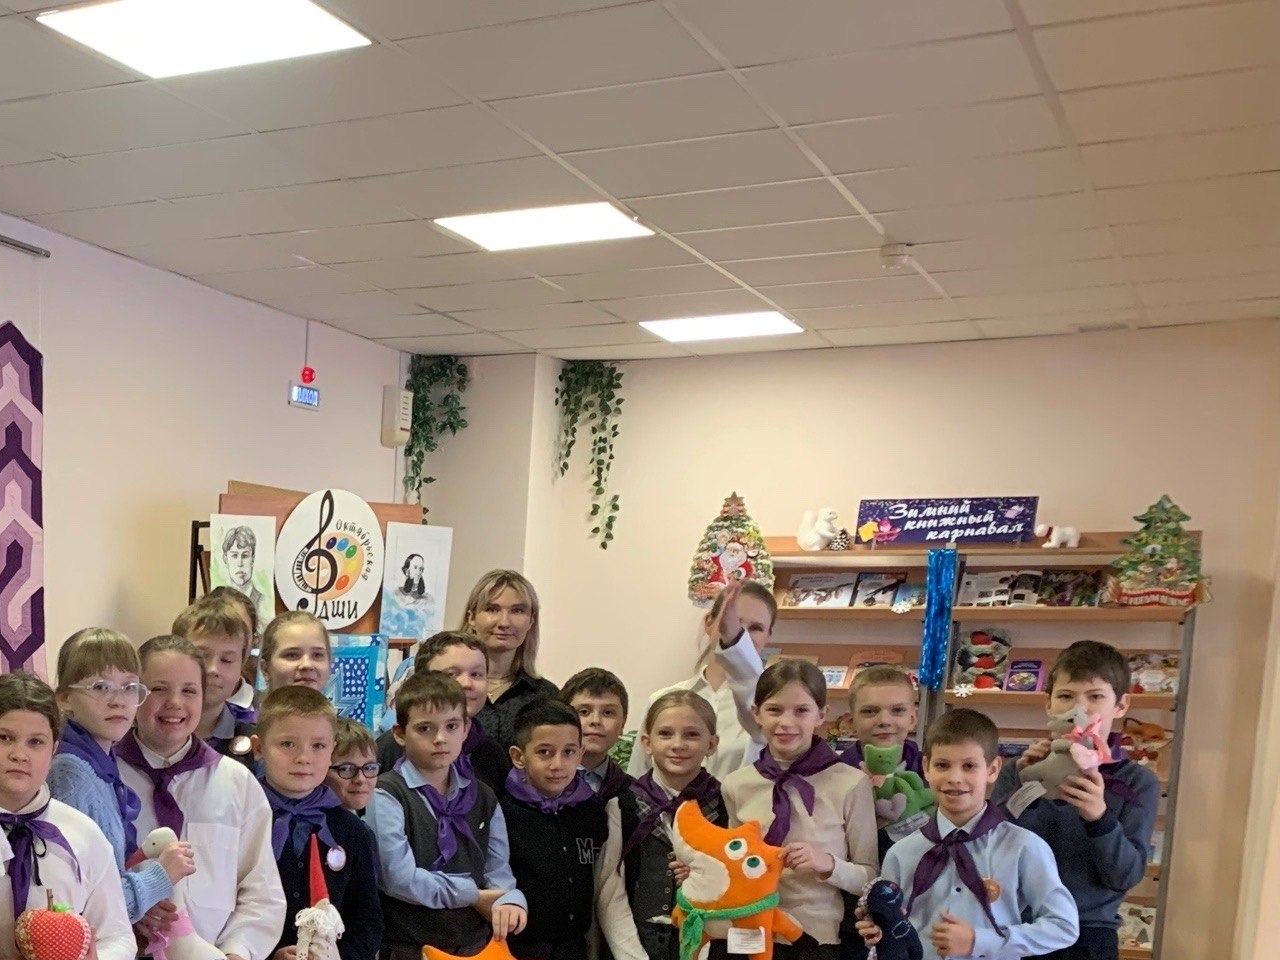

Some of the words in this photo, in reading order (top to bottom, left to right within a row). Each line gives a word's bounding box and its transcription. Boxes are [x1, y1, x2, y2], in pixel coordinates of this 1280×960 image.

[293, 386, 319, 406] ЫХОД
[889, 500, 971, 520] Зимний
[904, 510, 994, 531] книжный
[925, 522, 1024, 543] карнавал
[335, 519, 374, 581] Октябрьская
[317, 600, 358, 621] ДШИ
[576, 837, 602, 865] M
